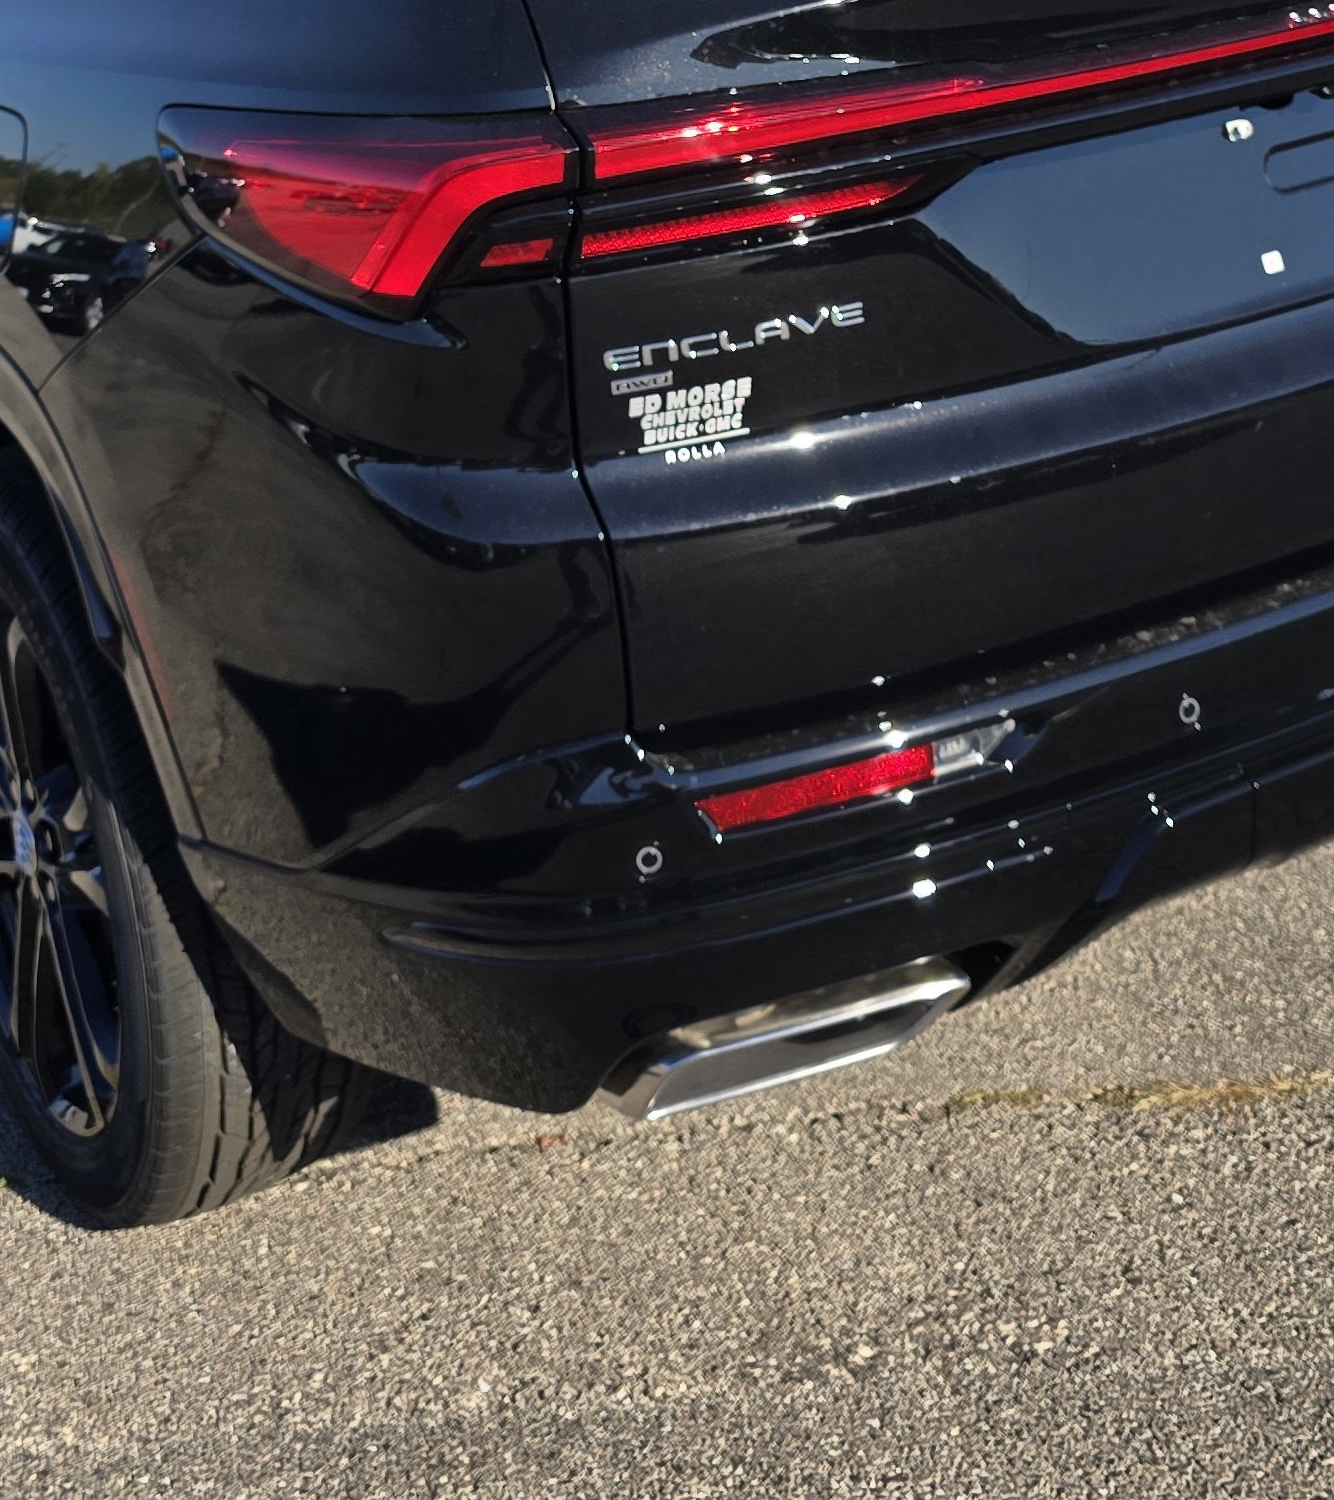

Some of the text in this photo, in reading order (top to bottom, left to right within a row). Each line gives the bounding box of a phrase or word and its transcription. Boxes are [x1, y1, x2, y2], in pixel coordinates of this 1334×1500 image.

[603, 300, 866, 372] ENCLAVE
[628, 376, 753, 419] ED MORSE
[640, 397, 746, 430] CHEVROLET
[664, 441, 727, 465] ROLLA
